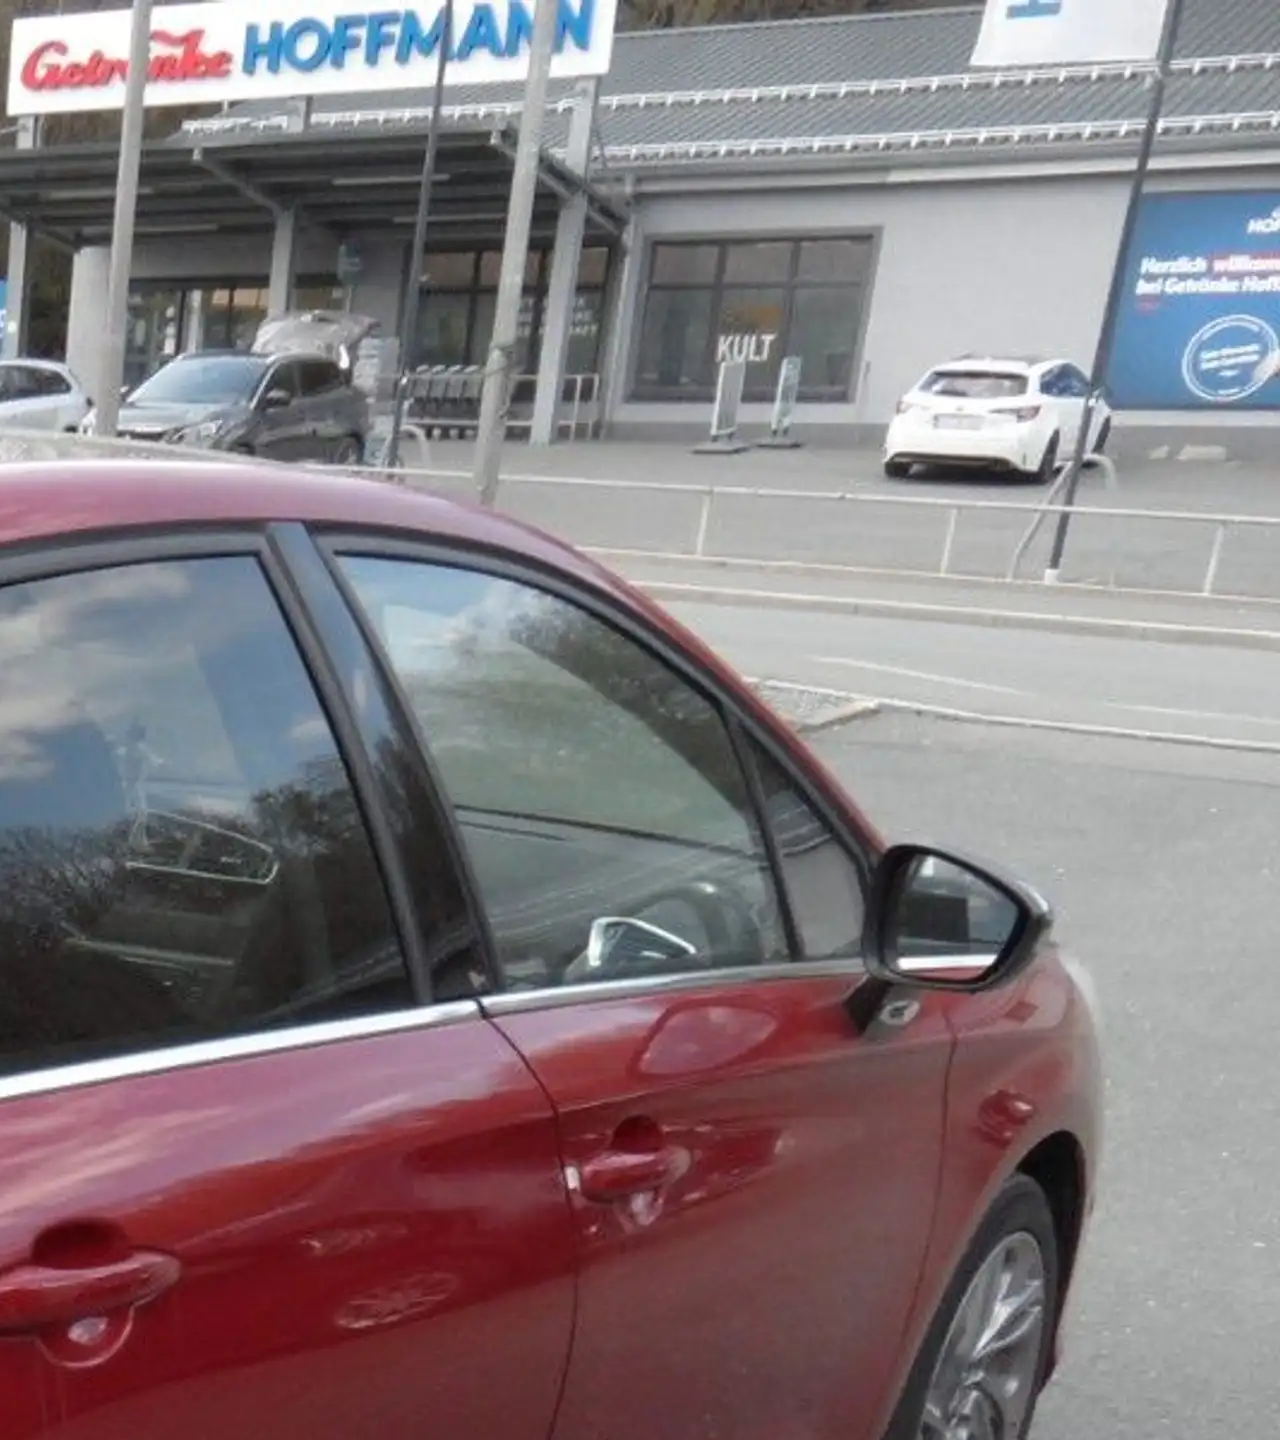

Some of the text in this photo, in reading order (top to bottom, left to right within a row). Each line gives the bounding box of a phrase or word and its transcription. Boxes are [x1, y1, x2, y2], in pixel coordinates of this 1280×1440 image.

[21, 0, 597, 90] Getrnke HOFFMANN
[716, 332, 778, 363] KULT
